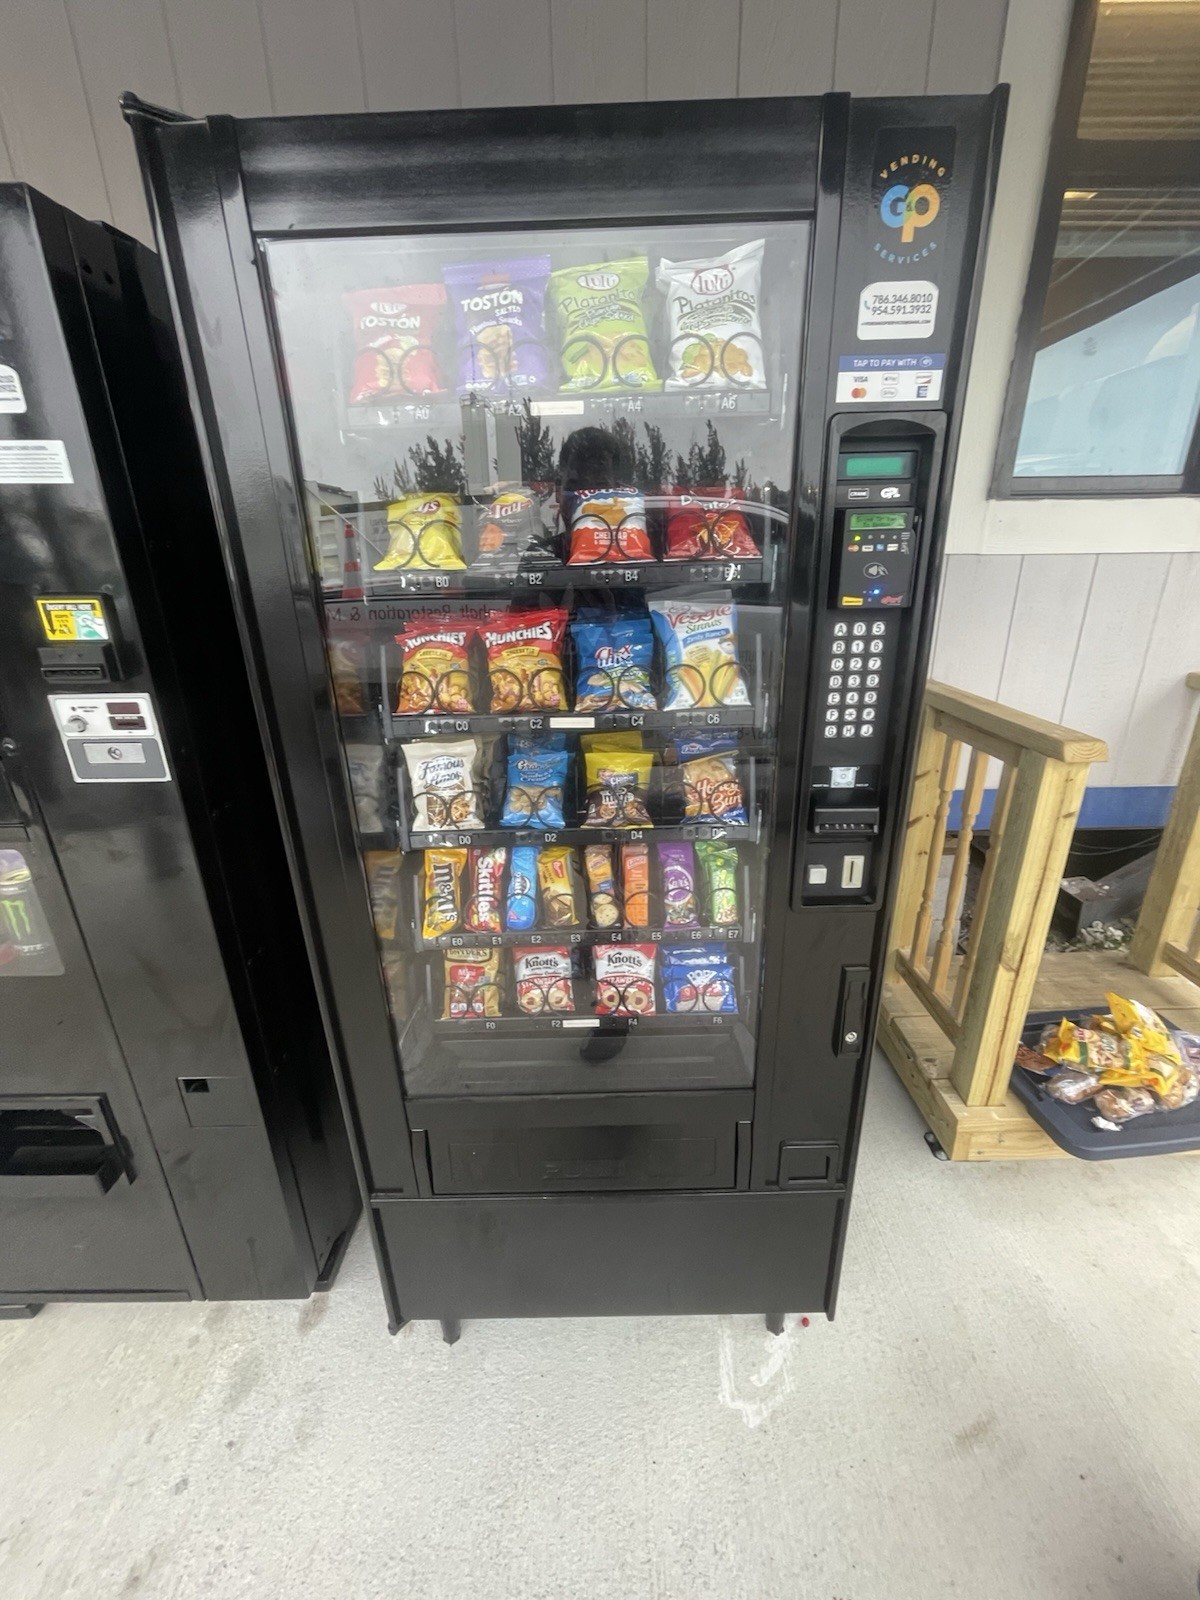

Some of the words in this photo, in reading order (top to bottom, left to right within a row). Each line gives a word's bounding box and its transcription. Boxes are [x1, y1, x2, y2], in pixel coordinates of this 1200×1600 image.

[879, 153, 946, 179] VENDING
[872, 241, 938, 264] SERVICES
[460, 287, 524, 312] TOSTÓN
[672, 290, 756, 314] Platanitos
[871, 293, 934, 305] 786.346.8010
[871, 304, 932, 316] 954.591.3932
[853, 359, 869, 367] TAP
[869, 359, 880, 367] TO
[881, 358, 896, 367] PAY
[897, 358, 918, 366] WITH
[627, 400, 642, 412] A4
[721, 396, 736, 409] A6
[508, 403, 523, 417] A2
[434, 576, 450, 588] B0
[528, 573, 543, 585] B2
[624, 570, 639, 582] B4
[666, 604, 732, 630] Veggie
[685, 618, 723, 634] Straws
[484, 621, 553, 649] MUNCHIES
[704, 630, 727, 640] Ranch
[403, 631, 467, 653] MUNCHIES
[529, 718, 543, 729] C2
[631, 714, 644, 726] C4
[707, 713, 720, 724] C6
[455, 720, 469, 731] C0
[418, 758, 466, 781] Famous
[710, 792, 743, 813] Bun
[458, 835, 472, 845] D0
[544, 833, 557, 843] D2
[630, 830, 643, 840] D4
[477, 856, 495, 923] Skittles
[531, 935, 542, 944] E2
[570, 934, 581, 944] E3
[611, 933, 622, 942] E4
[651, 932, 662, 941] E5
[691, 931, 702, 940] E6
[728, 930, 739, 939] E7
[452, 937, 463, 946] E0
[492, 937, 502, 945] E1
[525, 956, 559, 969] Knott's
[607, 952, 643, 968] Knott's
[486, 1022, 496, 1030] F0
[551, 1020, 561, 1028] F2
[628, 1018, 638, 1026] F4
[712, 1016, 723, 1025] F6
